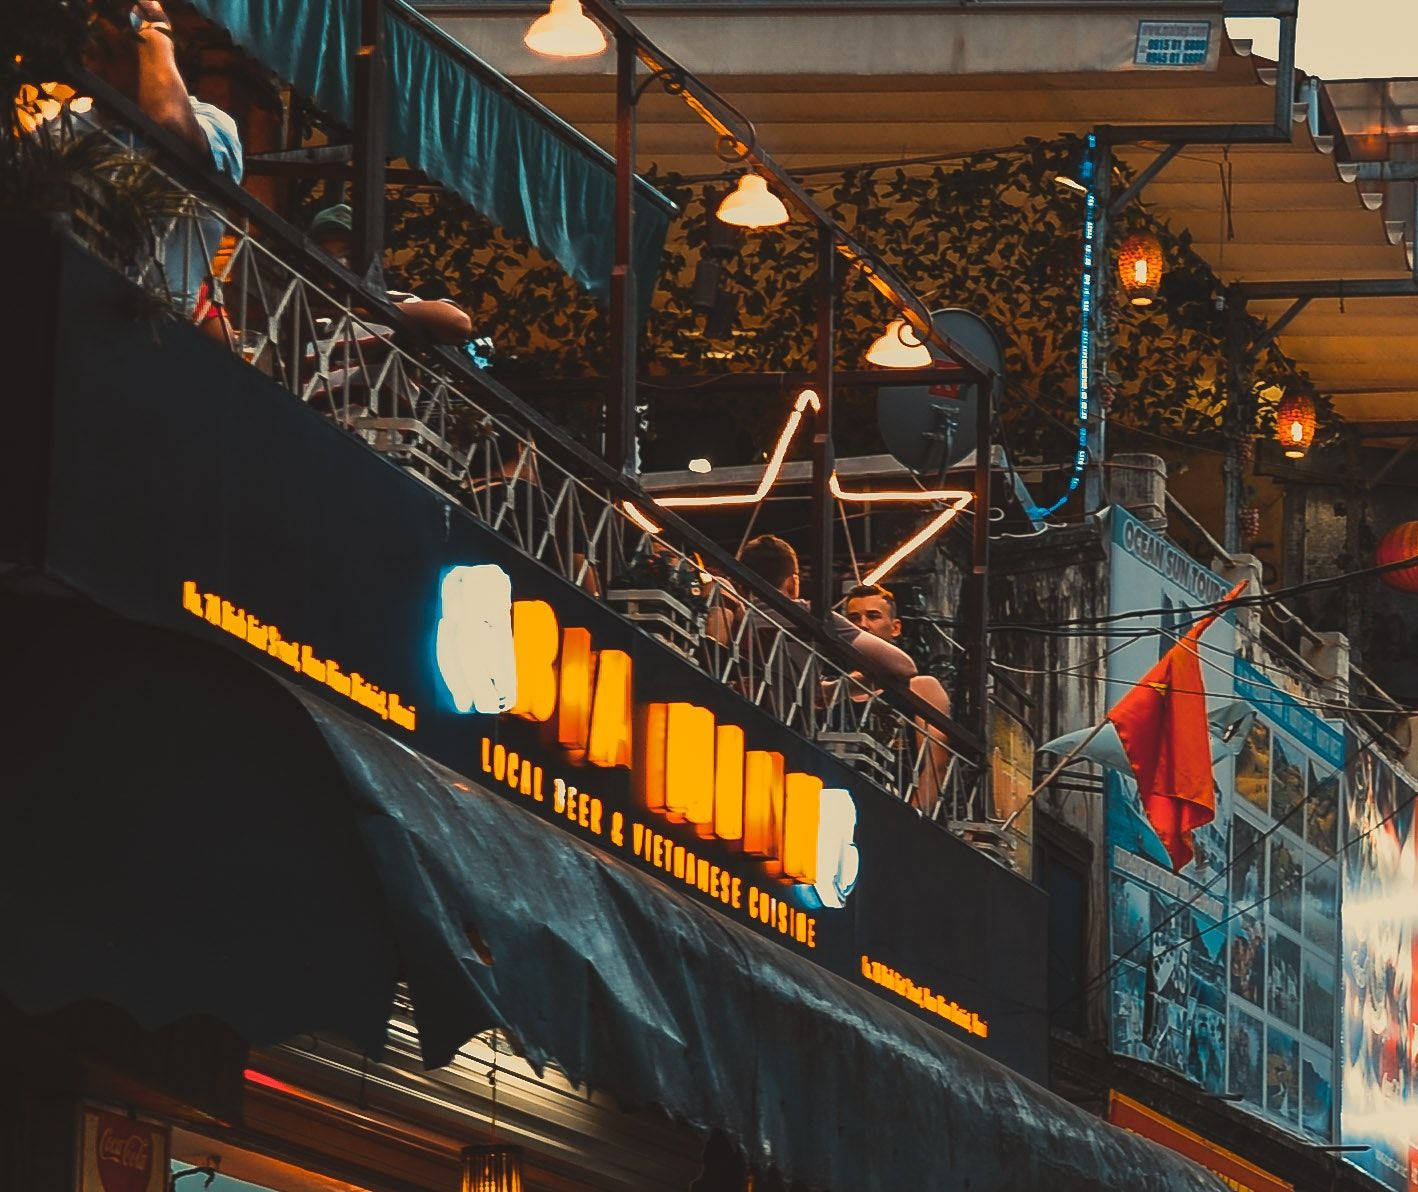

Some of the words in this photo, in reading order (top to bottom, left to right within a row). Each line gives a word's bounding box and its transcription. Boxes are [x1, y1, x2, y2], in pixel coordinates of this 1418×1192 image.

[1123, 519, 1164, 575] OCEAN
[482, 737, 543, 801] LOCAL
[553, 778, 602, 834] BEER
[611, 811, 624, 846] &
[633, 822, 741, 909] VIETNAMESE
[749, 886, 816, 948] CUISINE
